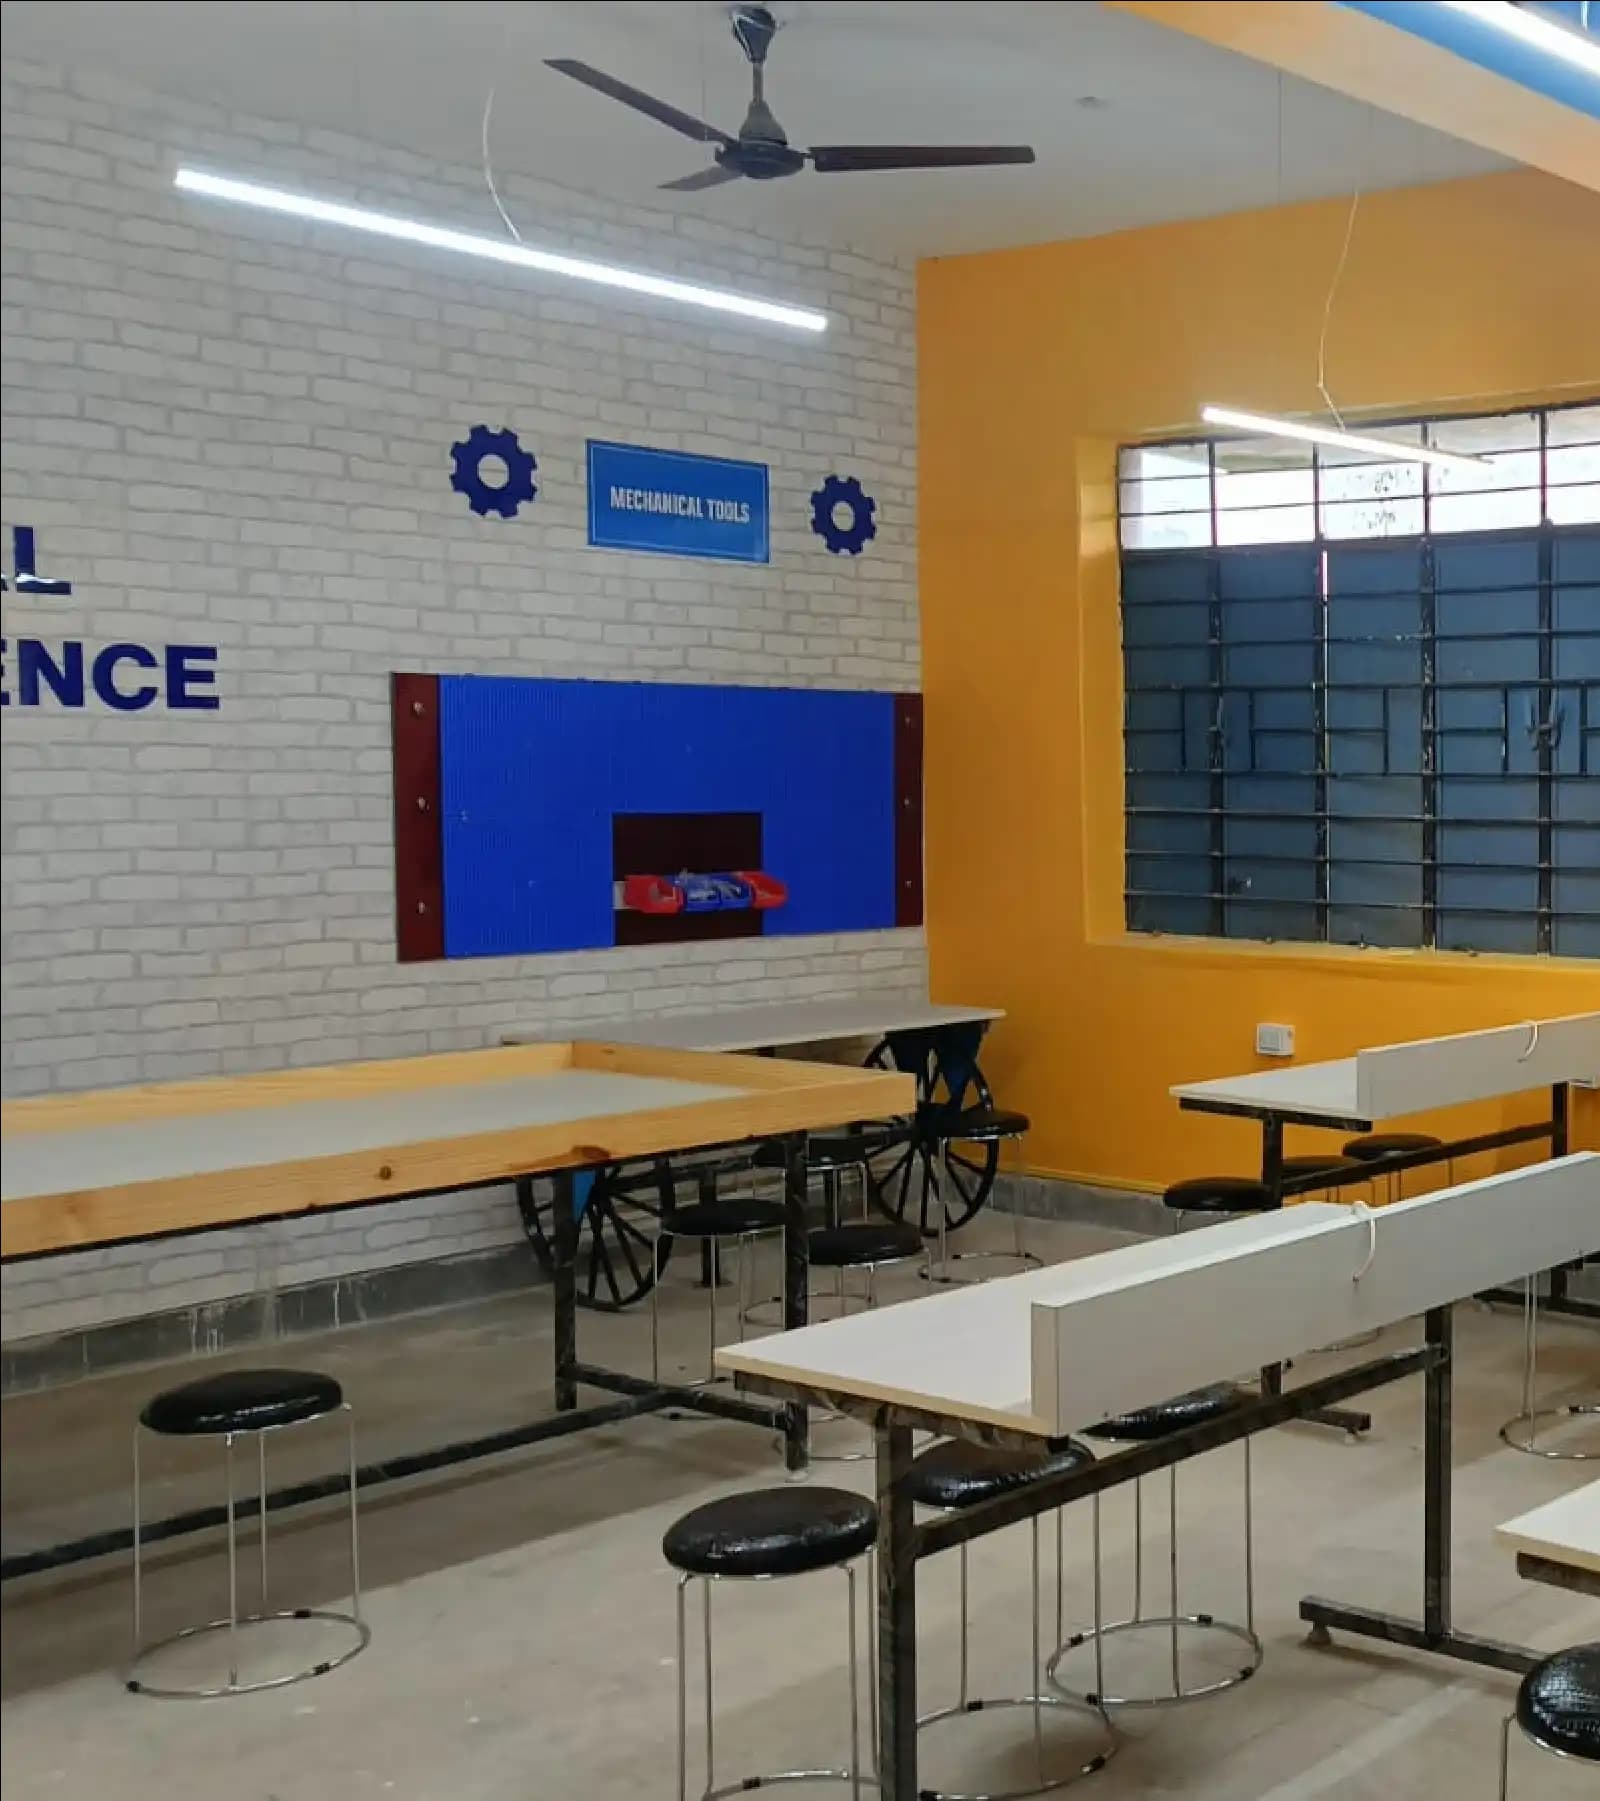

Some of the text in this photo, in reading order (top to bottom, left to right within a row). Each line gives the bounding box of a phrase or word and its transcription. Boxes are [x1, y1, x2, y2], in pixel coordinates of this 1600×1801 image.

[610, 486, 750, 524] MECHANICAL TOOLS
[1, 526, 72, 595] L
[1, 638, 220, 711] NCE
